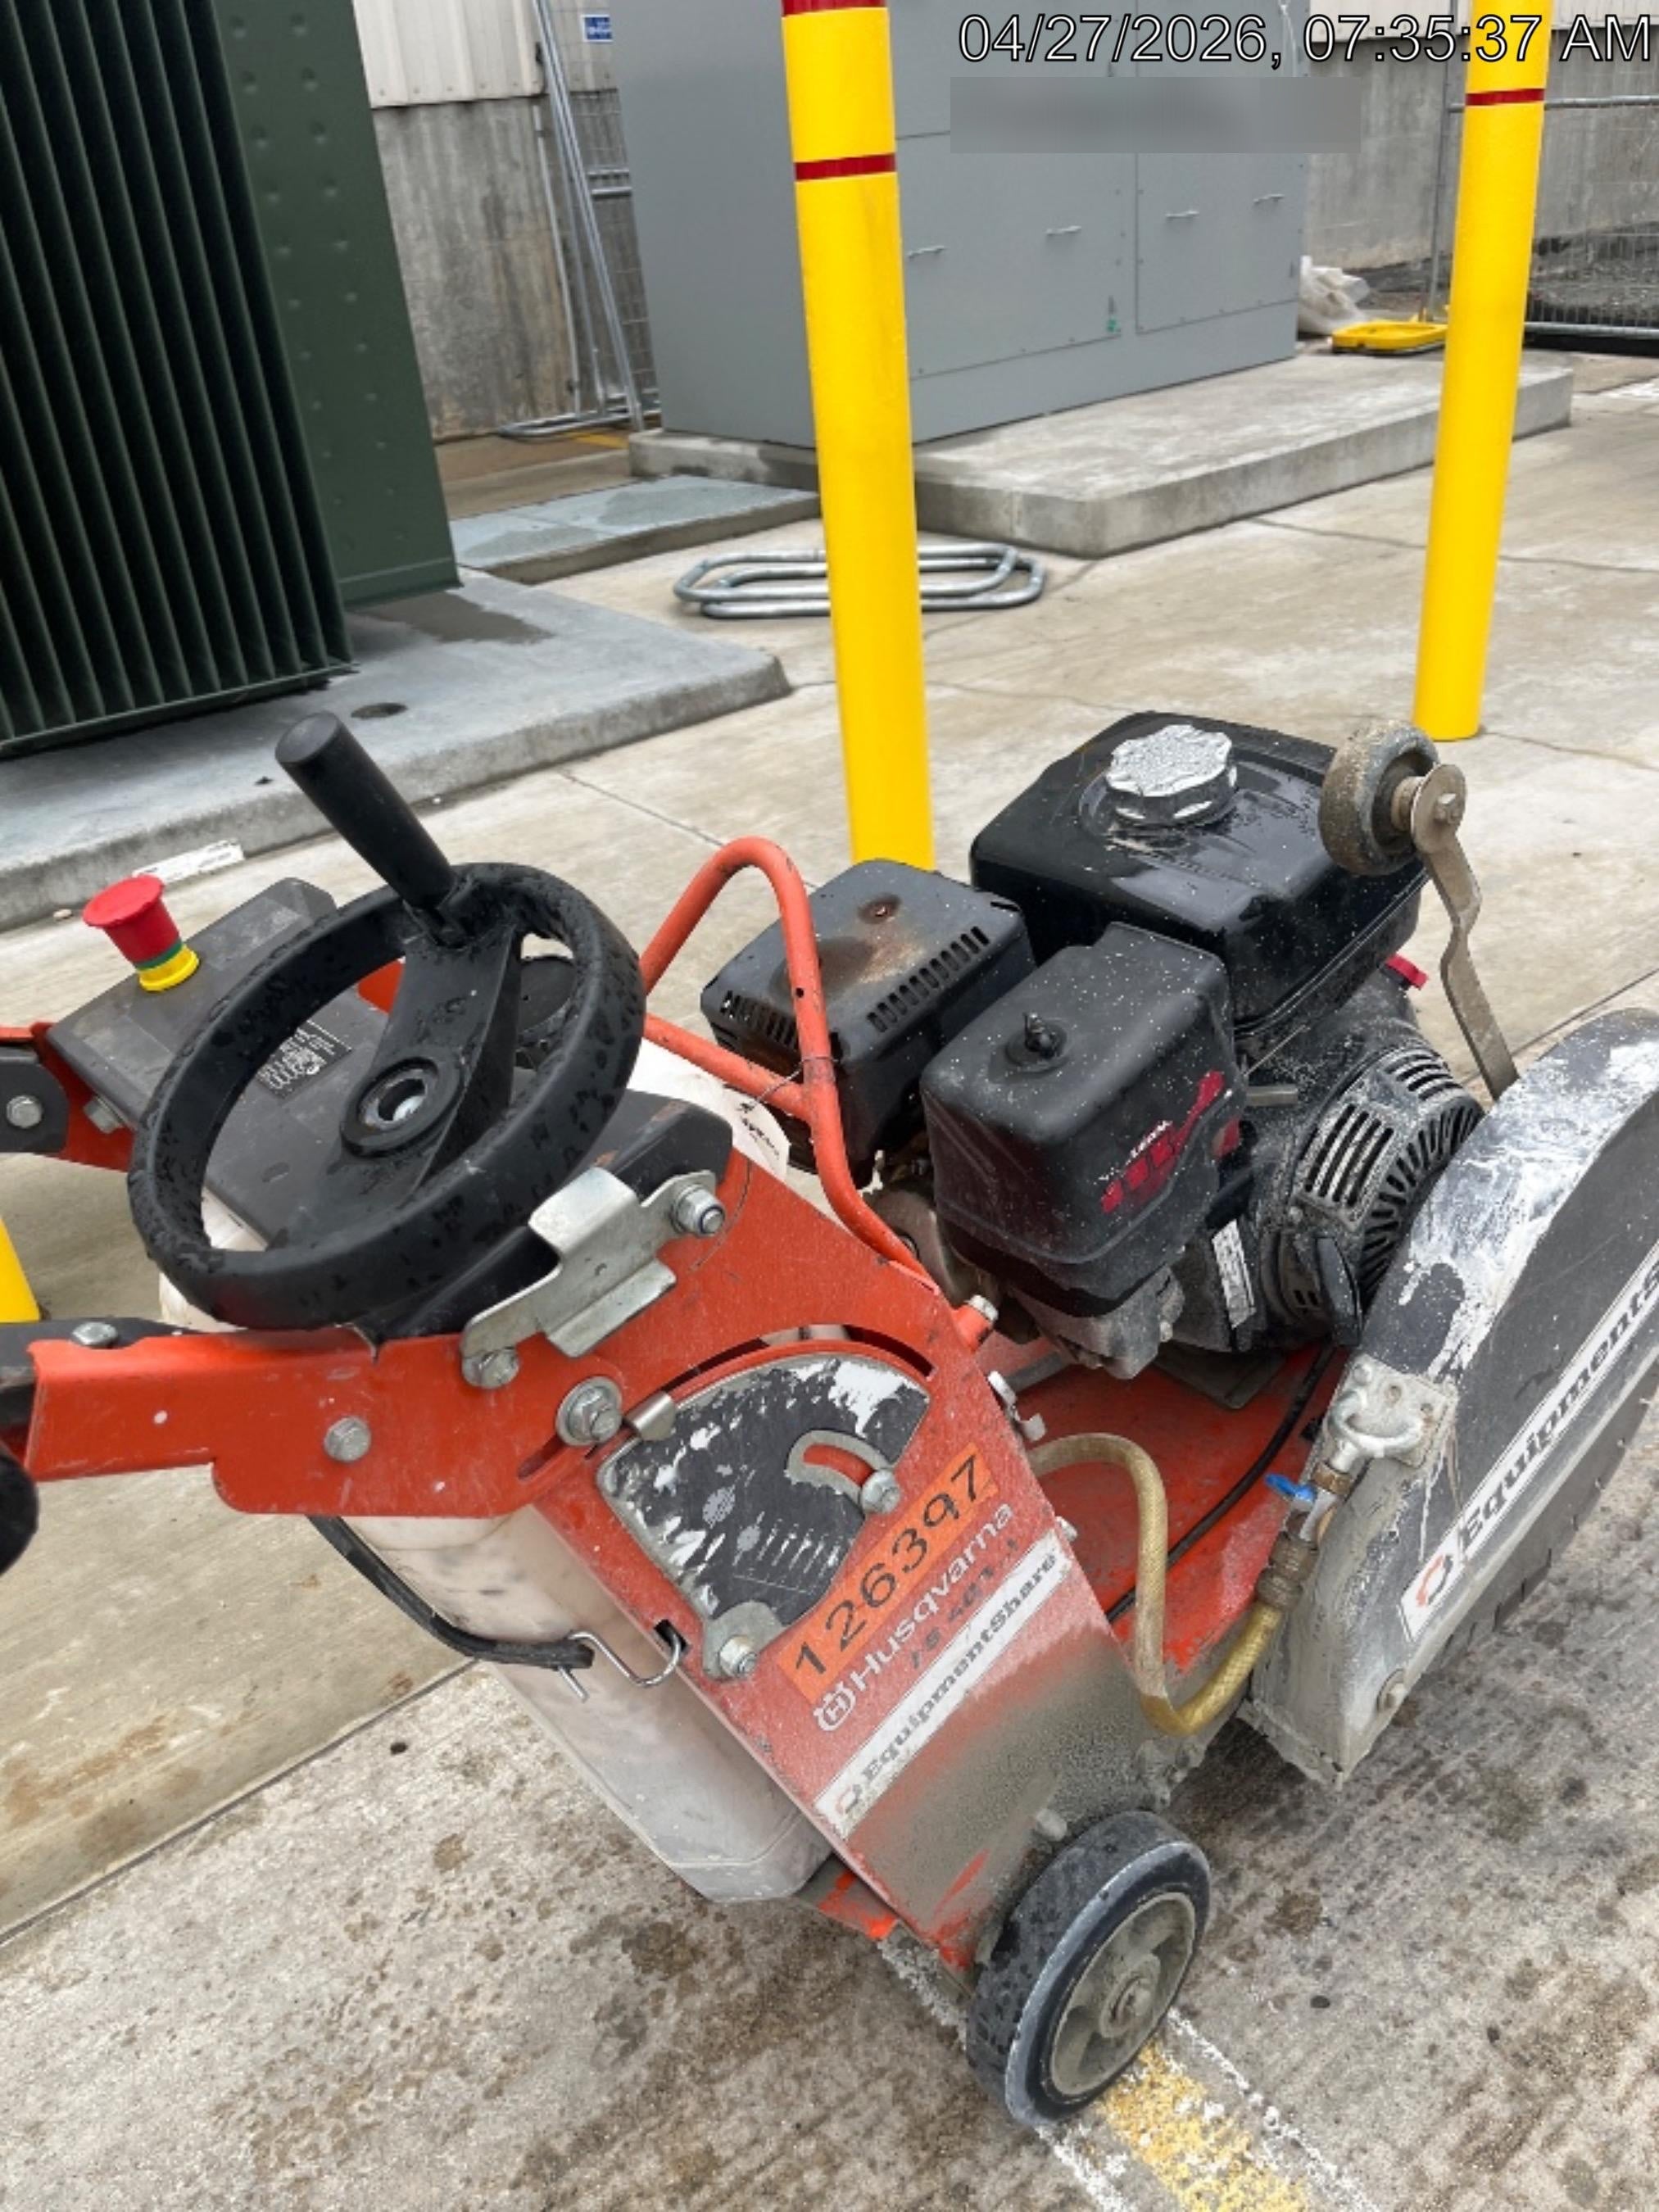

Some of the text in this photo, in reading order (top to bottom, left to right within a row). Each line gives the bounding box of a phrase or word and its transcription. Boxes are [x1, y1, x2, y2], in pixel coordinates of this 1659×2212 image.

[795, 1453, 983, 1675] 126397
[850, 1503, 1013, 1693] Husqvarna
[863, 1552, 1056, 1778] EquipmentShare
